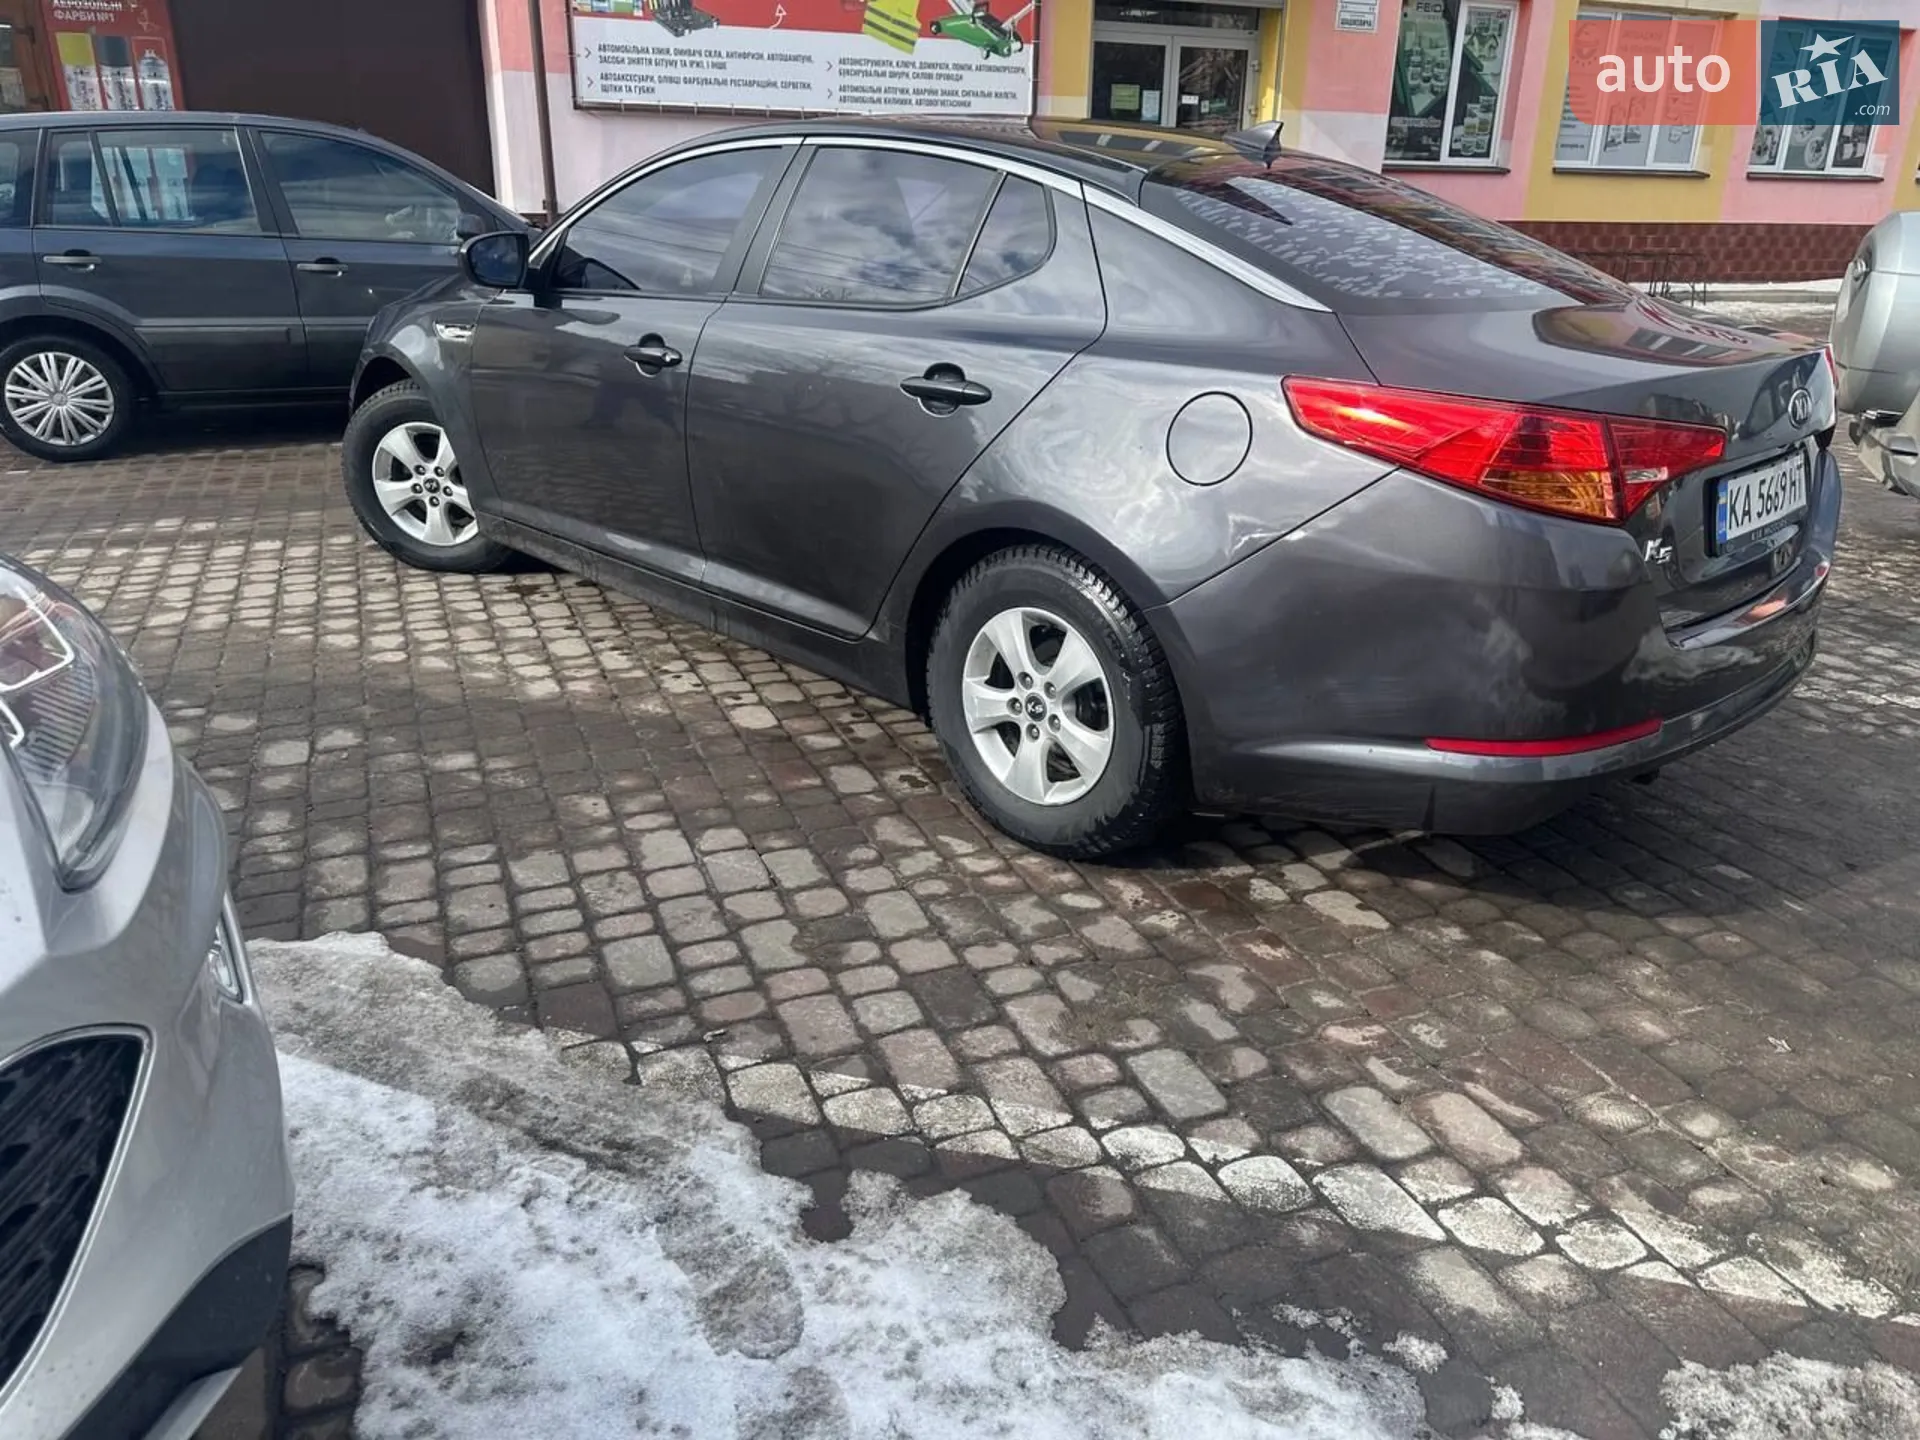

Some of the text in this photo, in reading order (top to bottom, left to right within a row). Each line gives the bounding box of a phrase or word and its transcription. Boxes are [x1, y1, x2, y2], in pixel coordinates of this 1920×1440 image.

[1729, 460, 1803, 530] KA 5669 HT
[1643, 537, 1673, 565] K5
